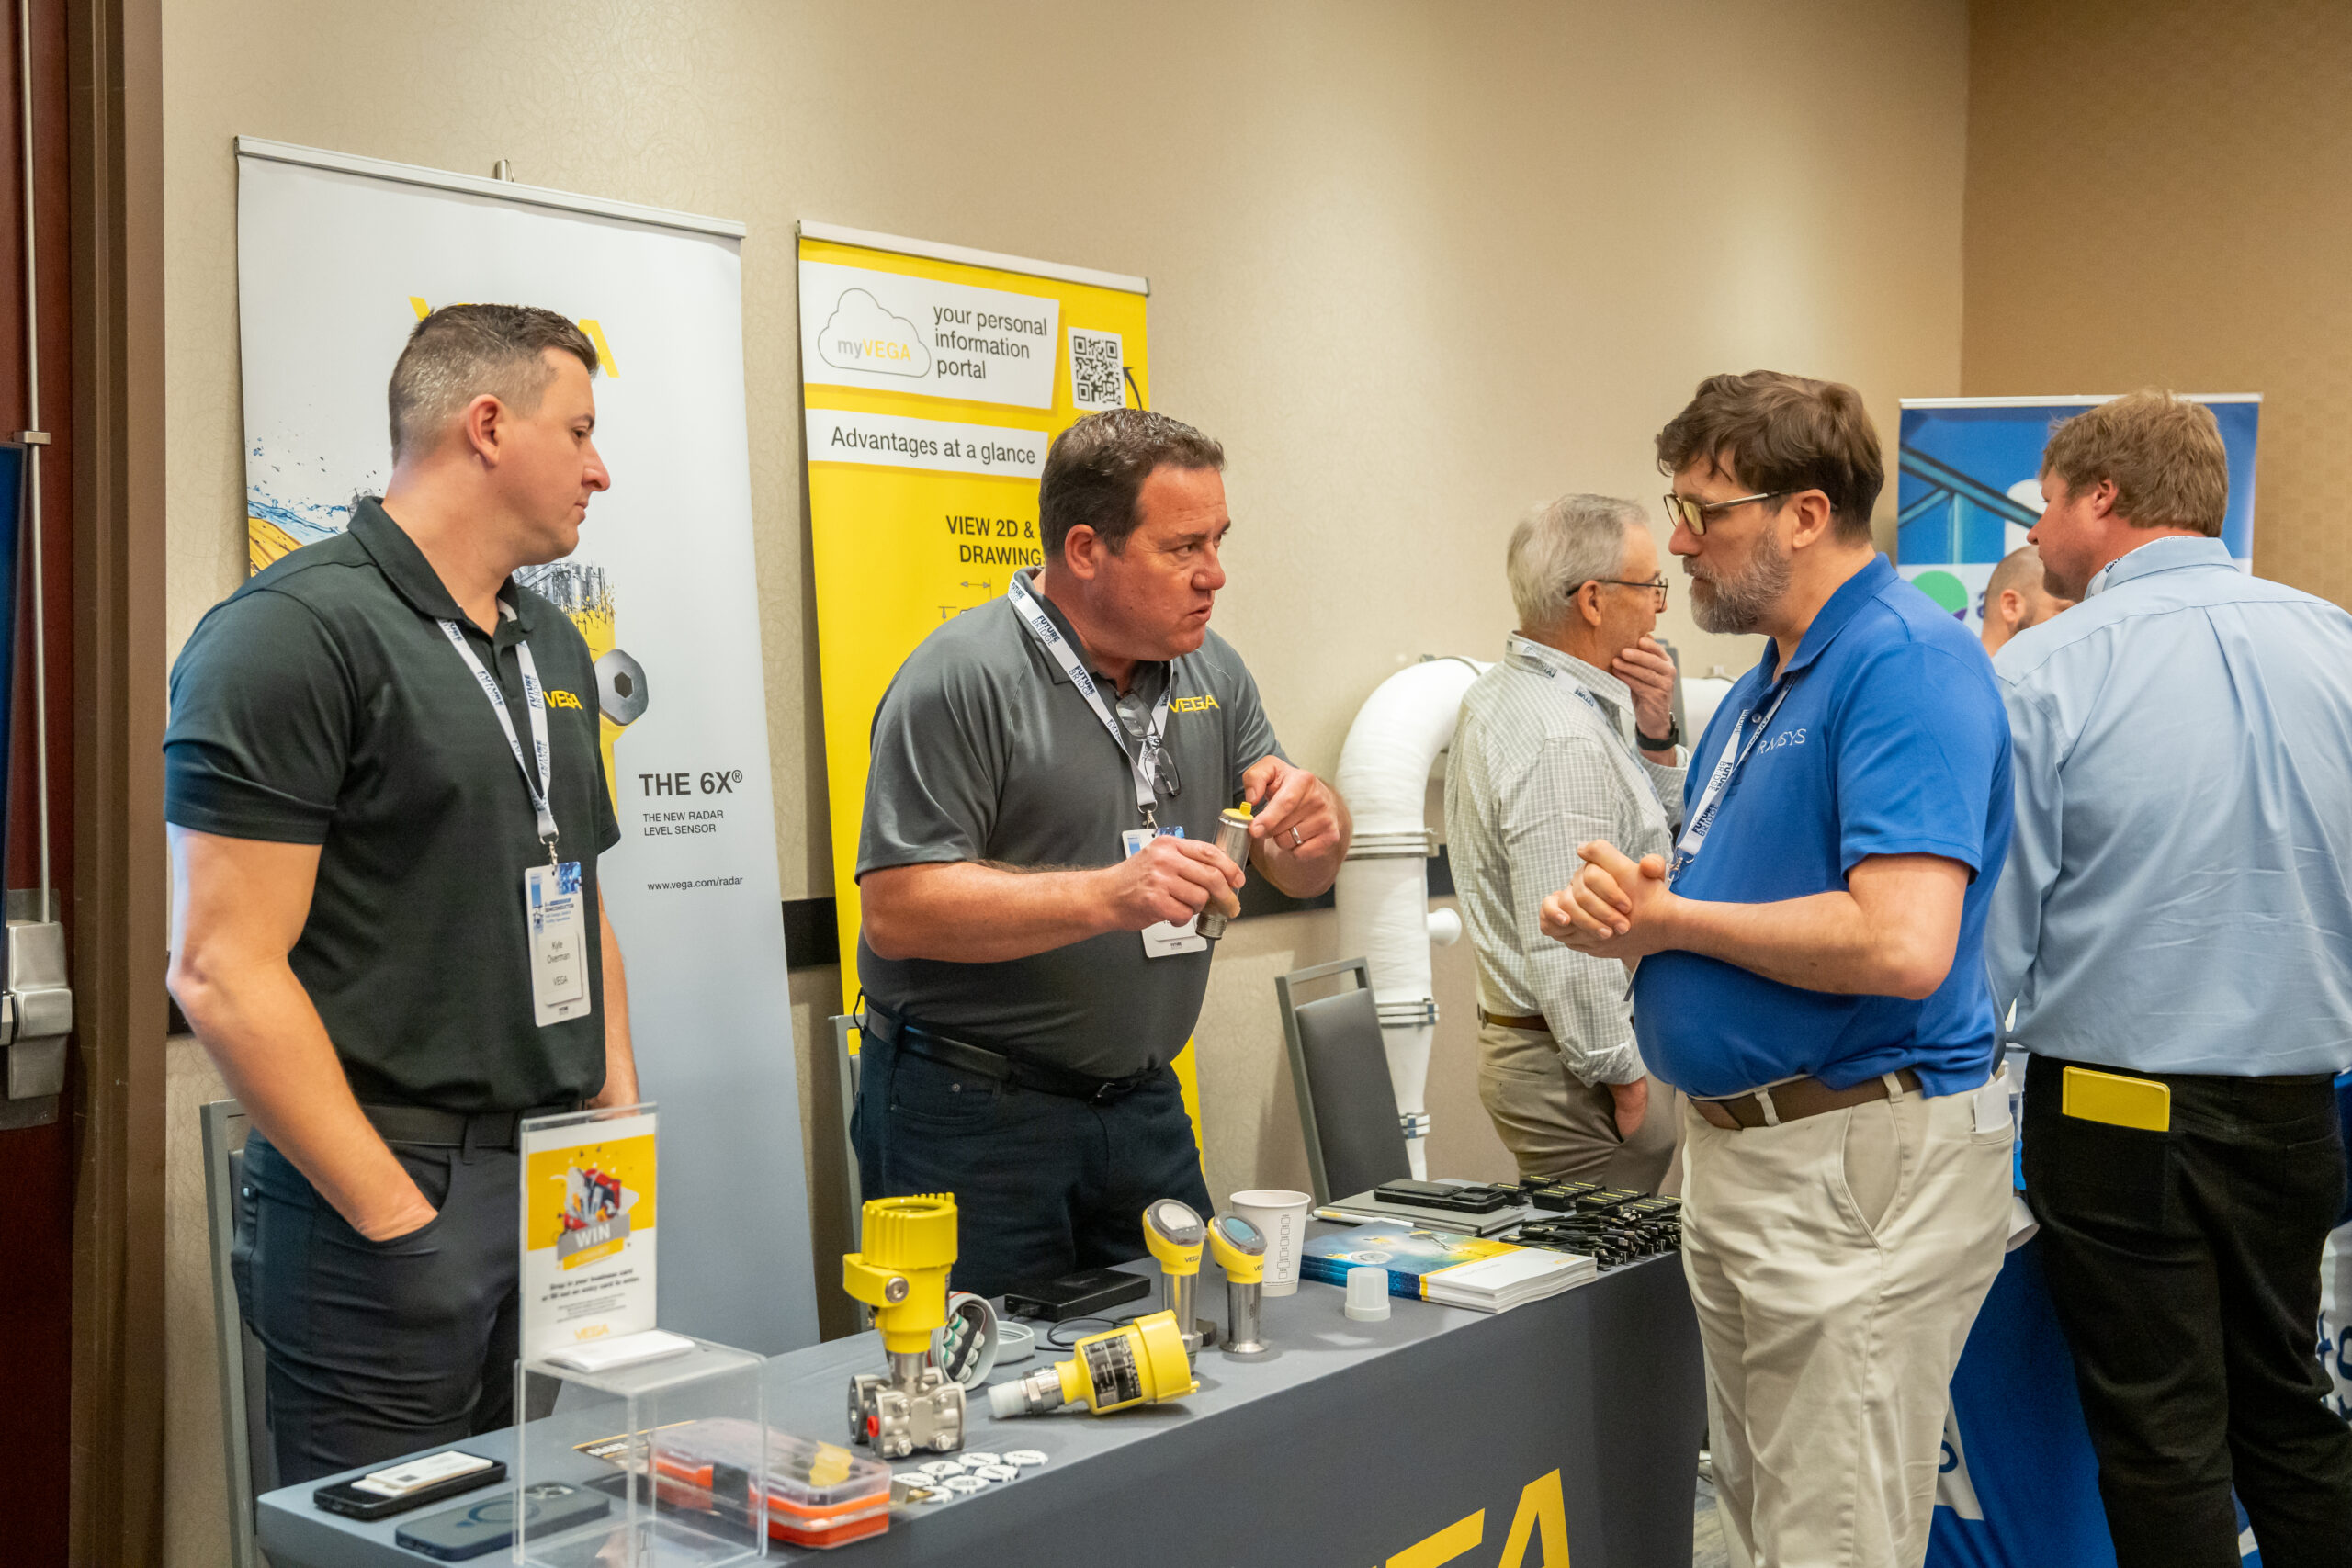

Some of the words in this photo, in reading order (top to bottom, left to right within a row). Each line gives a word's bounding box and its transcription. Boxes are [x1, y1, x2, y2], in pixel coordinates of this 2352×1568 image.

[933, 306, 971, 326] your
[977, 312, 1047, 336] personal
[837, 338, 911, 362] myVEGA
[935, 328, 1030, 359] information
[937, 358, 987, 379] portal
[831, 426, 938, 458] Advantages
[944, 439, 960, 457] at
[967, 444, 977, 458] a
[981, 442, 1035, 465] glance
[946, 515, 990, 536] VIEW
[996, 519, 1018, 537] 2D
[1023, 521, 1035, 539] &
[959, 545, 1045, 566] DRAWING
[1031, 618, 1056, 647] BRIDGE
[1037, 615, 1061, 642] FUTURE
[1069, 669, 1091, 698] BRIDGE
[1074, 665, 1096, 694] FUTURE
[543, 690, 583, 710] VEGA
[1168, 694, 1220, 713] VEGA
[639, 773, 691, 796] THE
[1708, 761, 1727, 791] BRIDGE
[643, 812, 662, 822] THE
[663, 811, 685, 821] NEW
[689, 810, 724, 820] RADAR
[1691, 803, 1715, 834] FUTURE
[1698, 803, 1719, 837] BRIDGE
[644, 826, 673, 836] LEVEL
[674, 824, 717, 835] SENSOR
[648, 876, 743, 891] www.vega.com/radar
[574, 1223, 611, 1248] WIN
